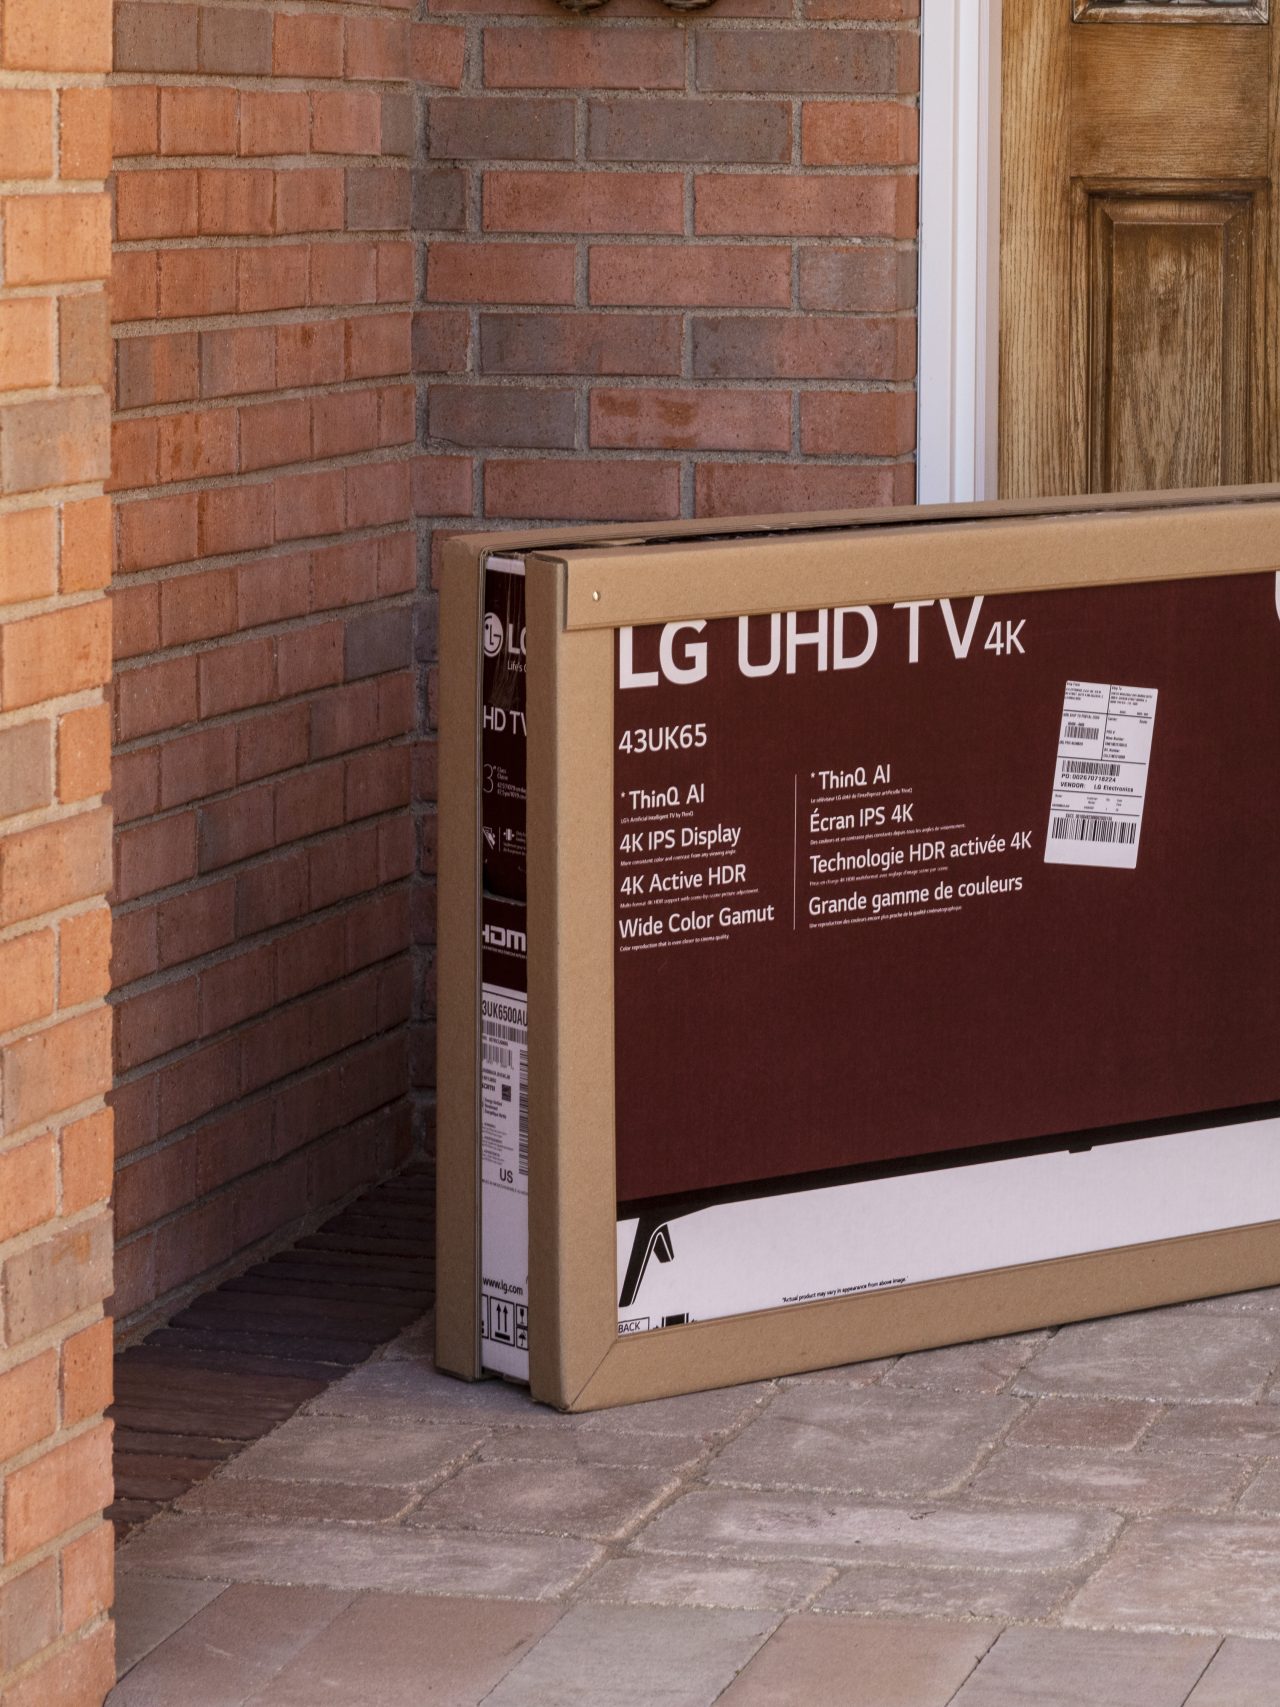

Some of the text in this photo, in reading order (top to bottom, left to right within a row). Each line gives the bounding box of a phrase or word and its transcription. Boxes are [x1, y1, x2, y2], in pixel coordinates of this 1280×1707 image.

[619, 595, 1026, 689] LG UHD TV 4K
[507, 660, 523, 672] Life's
[618, 723, 708, 754] 43UK65
[818, 763, 891, 790] ThinQ AI
[1103, 785, 1134, 793] Electronics
[629, 783, 705, 811] ThinQ AI
[810, 803, 914, 833] Écran IPS 4K
[619, 823, 741, 853] 4K IPS Display
[809, 830, 1033, 874] Technologie HDR activée 4K
[620, 863, 746, 896] 4K Active HDR
[808, 875, 1023, 916] Grande gamme de couleurs
[619, 904, 775, 939] Wide Color Gamut
[715, 933, 730, 941] quality
[499, 1167, 514, 1184] US
[482, 1277, 523, 1296] www.lg.com
[798, 1292, 816, 1301] product
[842, 1284, 867, 1294] appearance
[618, 1321, 641, 1334] BACK
